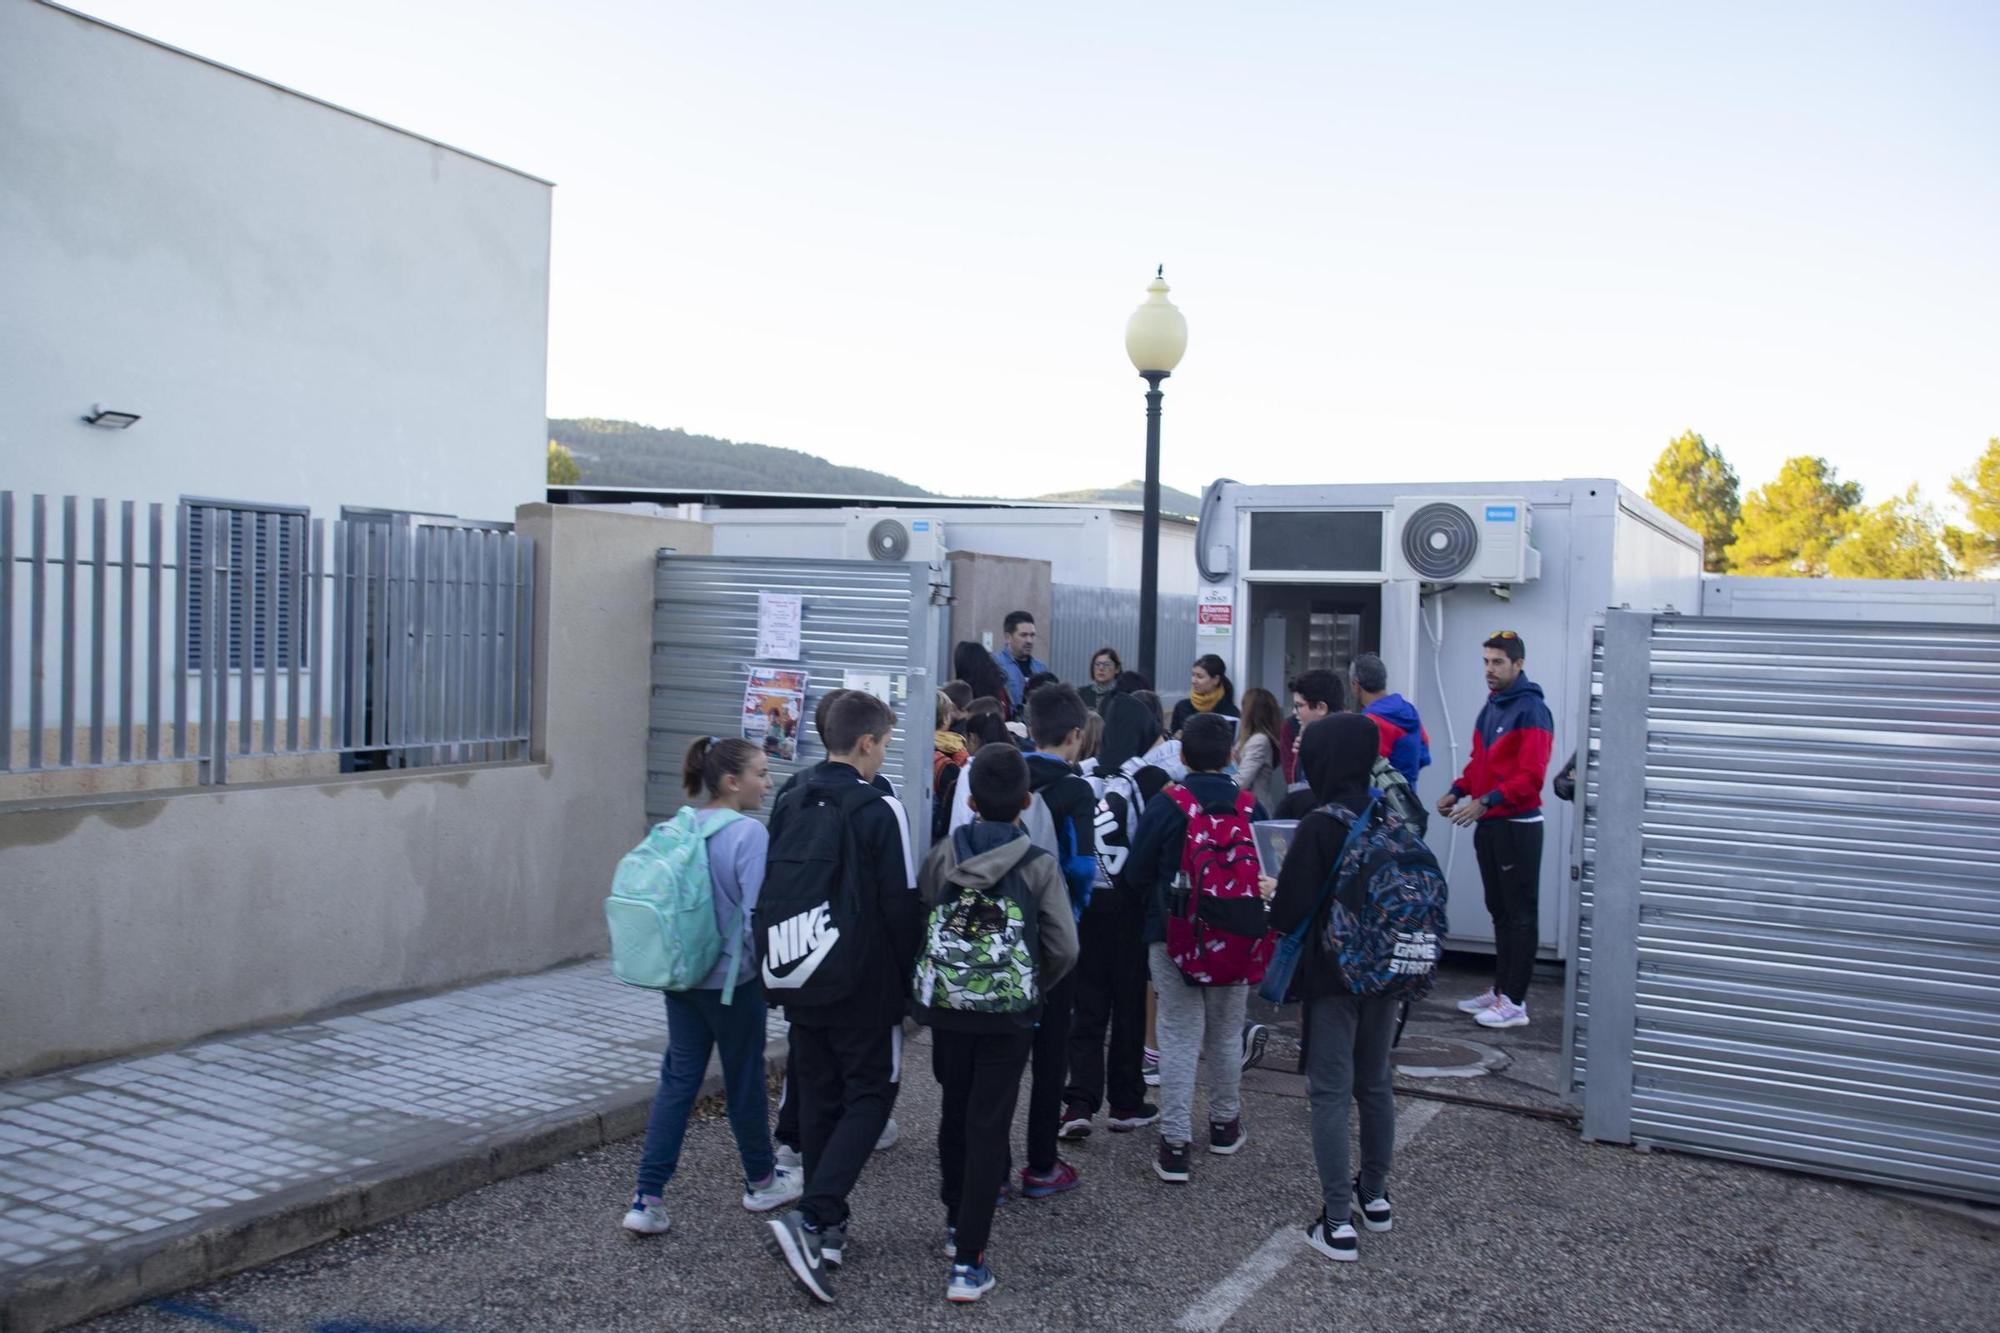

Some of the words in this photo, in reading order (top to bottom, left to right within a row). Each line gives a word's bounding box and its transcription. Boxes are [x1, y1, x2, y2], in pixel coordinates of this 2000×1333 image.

[767, 900, 840, 970] NIKE
[1393, 942, 1436, 959] GAME
[1388, 958, 1434, 975] START
